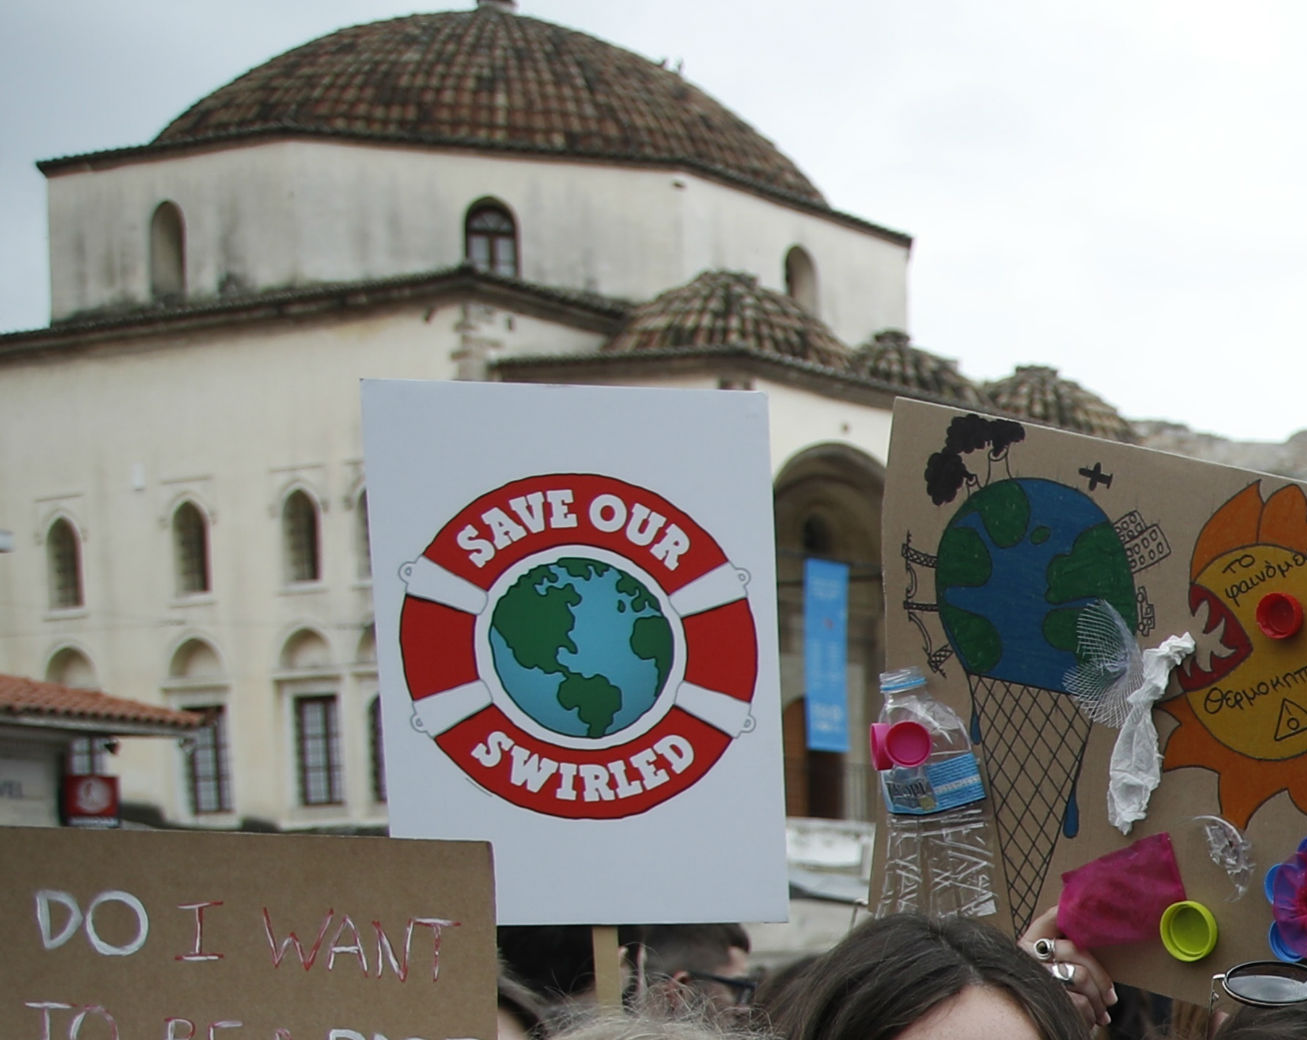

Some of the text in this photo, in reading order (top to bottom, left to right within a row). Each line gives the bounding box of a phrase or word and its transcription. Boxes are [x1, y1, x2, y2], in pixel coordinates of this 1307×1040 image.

[457, 489, 691, 572] SAVE OUR
[471, 731, 696, 802] SWIRLED
[35, 889, 462, 982] DO I WANT
